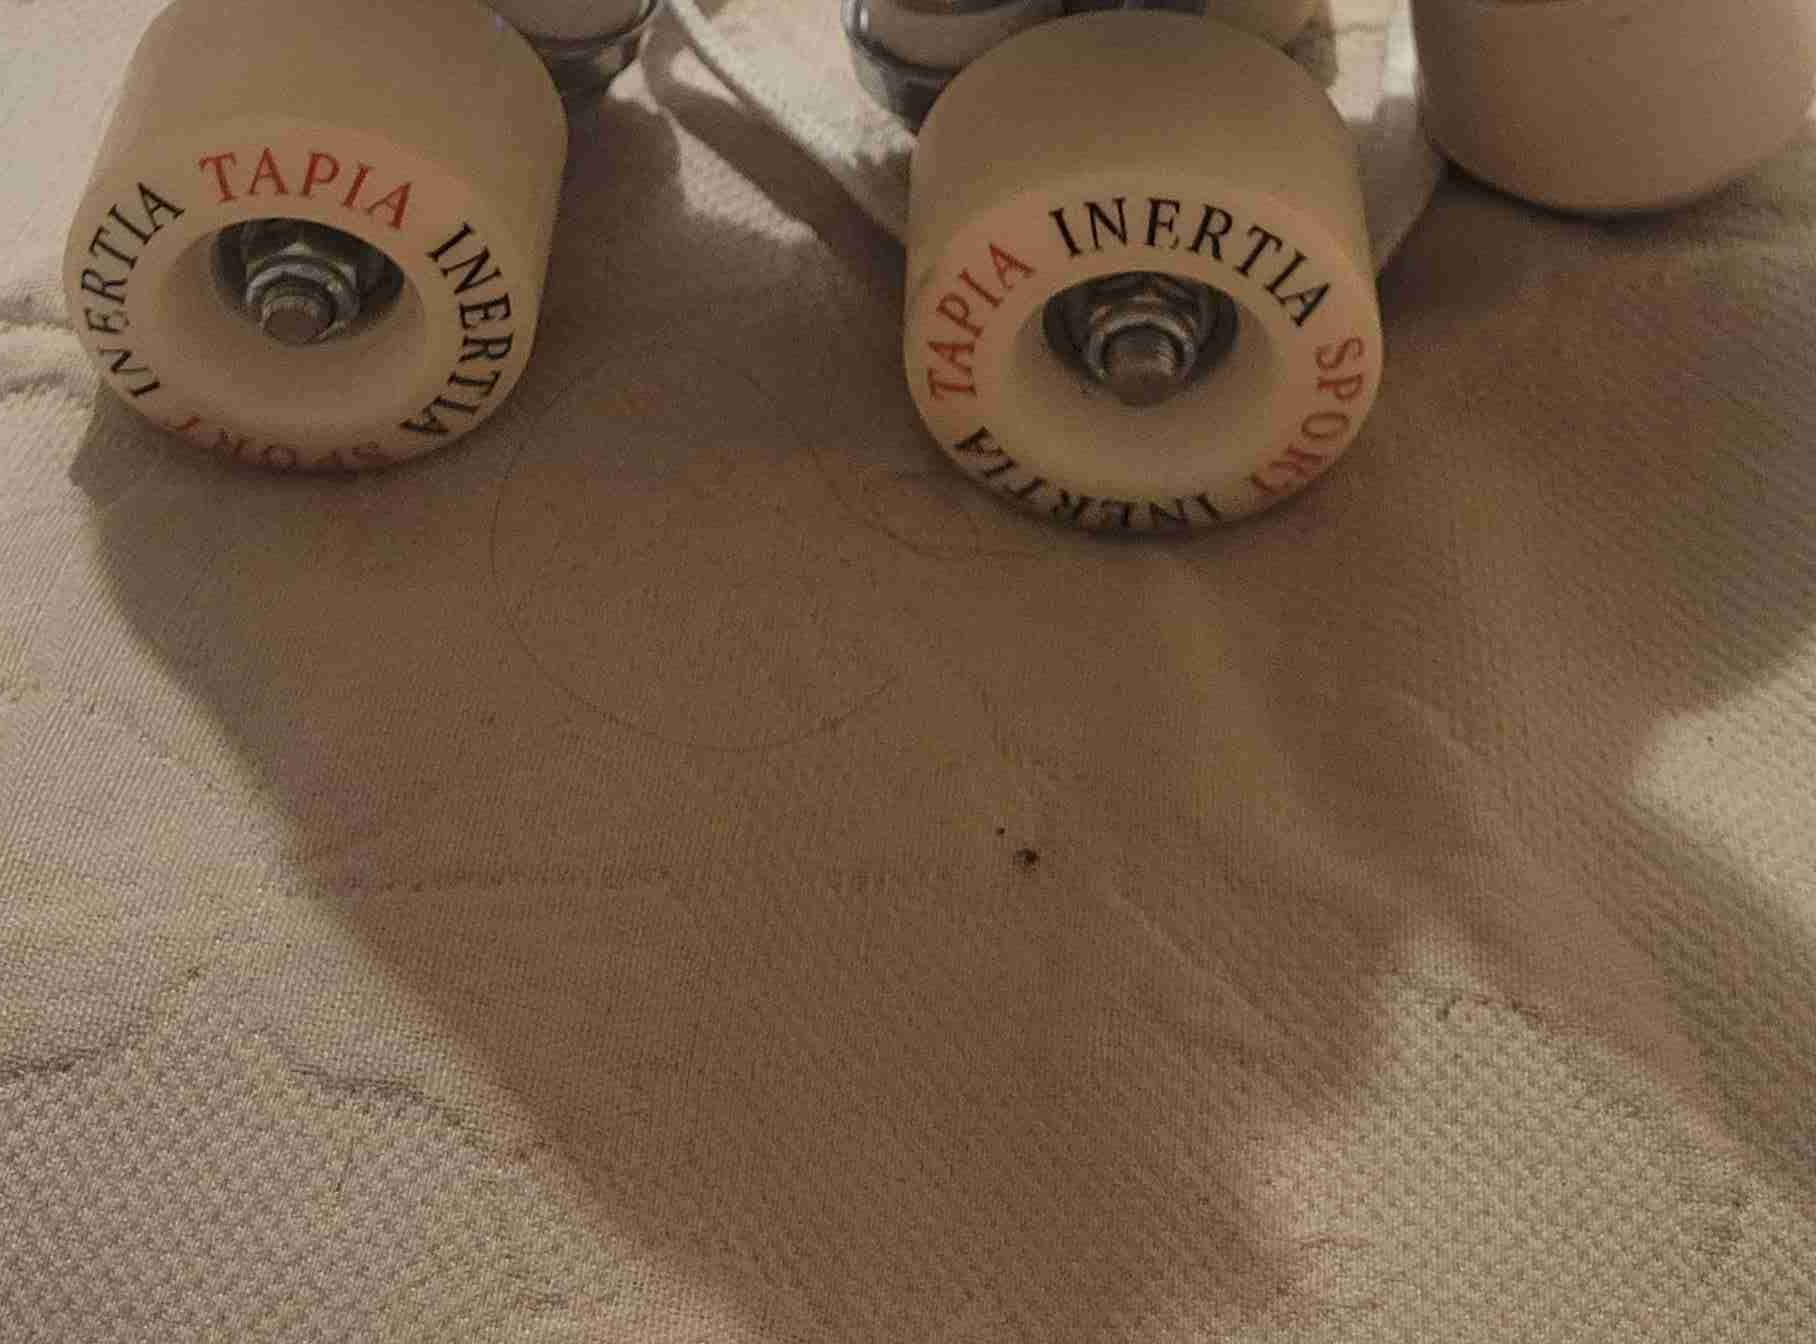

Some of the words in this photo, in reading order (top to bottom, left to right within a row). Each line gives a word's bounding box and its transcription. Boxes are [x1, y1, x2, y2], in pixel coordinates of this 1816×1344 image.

[80, 181, 186, 400] INERTIA
[199, 147, 414, 231] TAPIA
[401, 222, 514, 438] INERTIA
[926, 240, 1037, 401] TAPIA
[1049, 196, 1332, 328] INERTIA
[1248, 336, 1365, 498] SPORT
